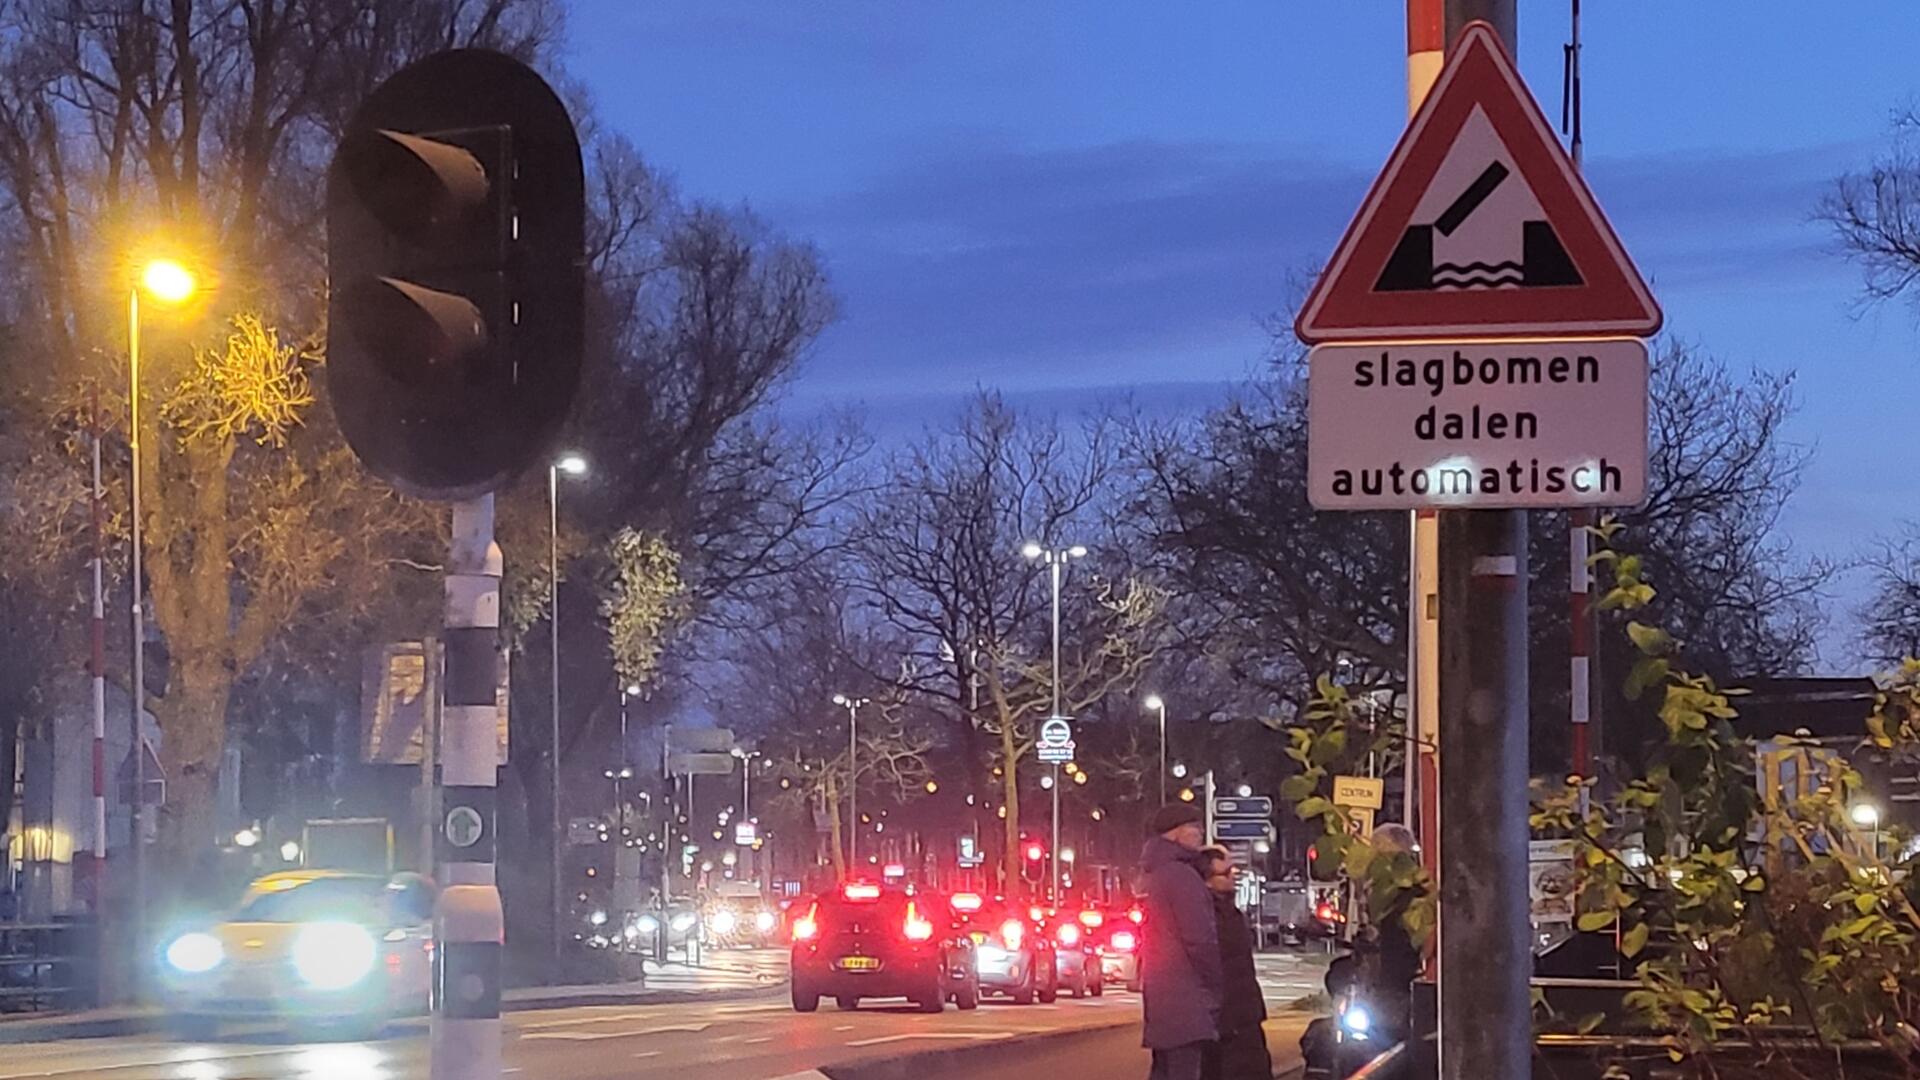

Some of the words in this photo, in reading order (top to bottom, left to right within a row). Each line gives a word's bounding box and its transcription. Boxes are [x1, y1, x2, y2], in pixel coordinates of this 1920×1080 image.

[1354, 350, 1600, 397] slagbomen
[1414, 404, 1538, 441] dalen
[1331, 458, 1622, 497] automatisch
[1340, 786, 1374, 799] CENTRUM
